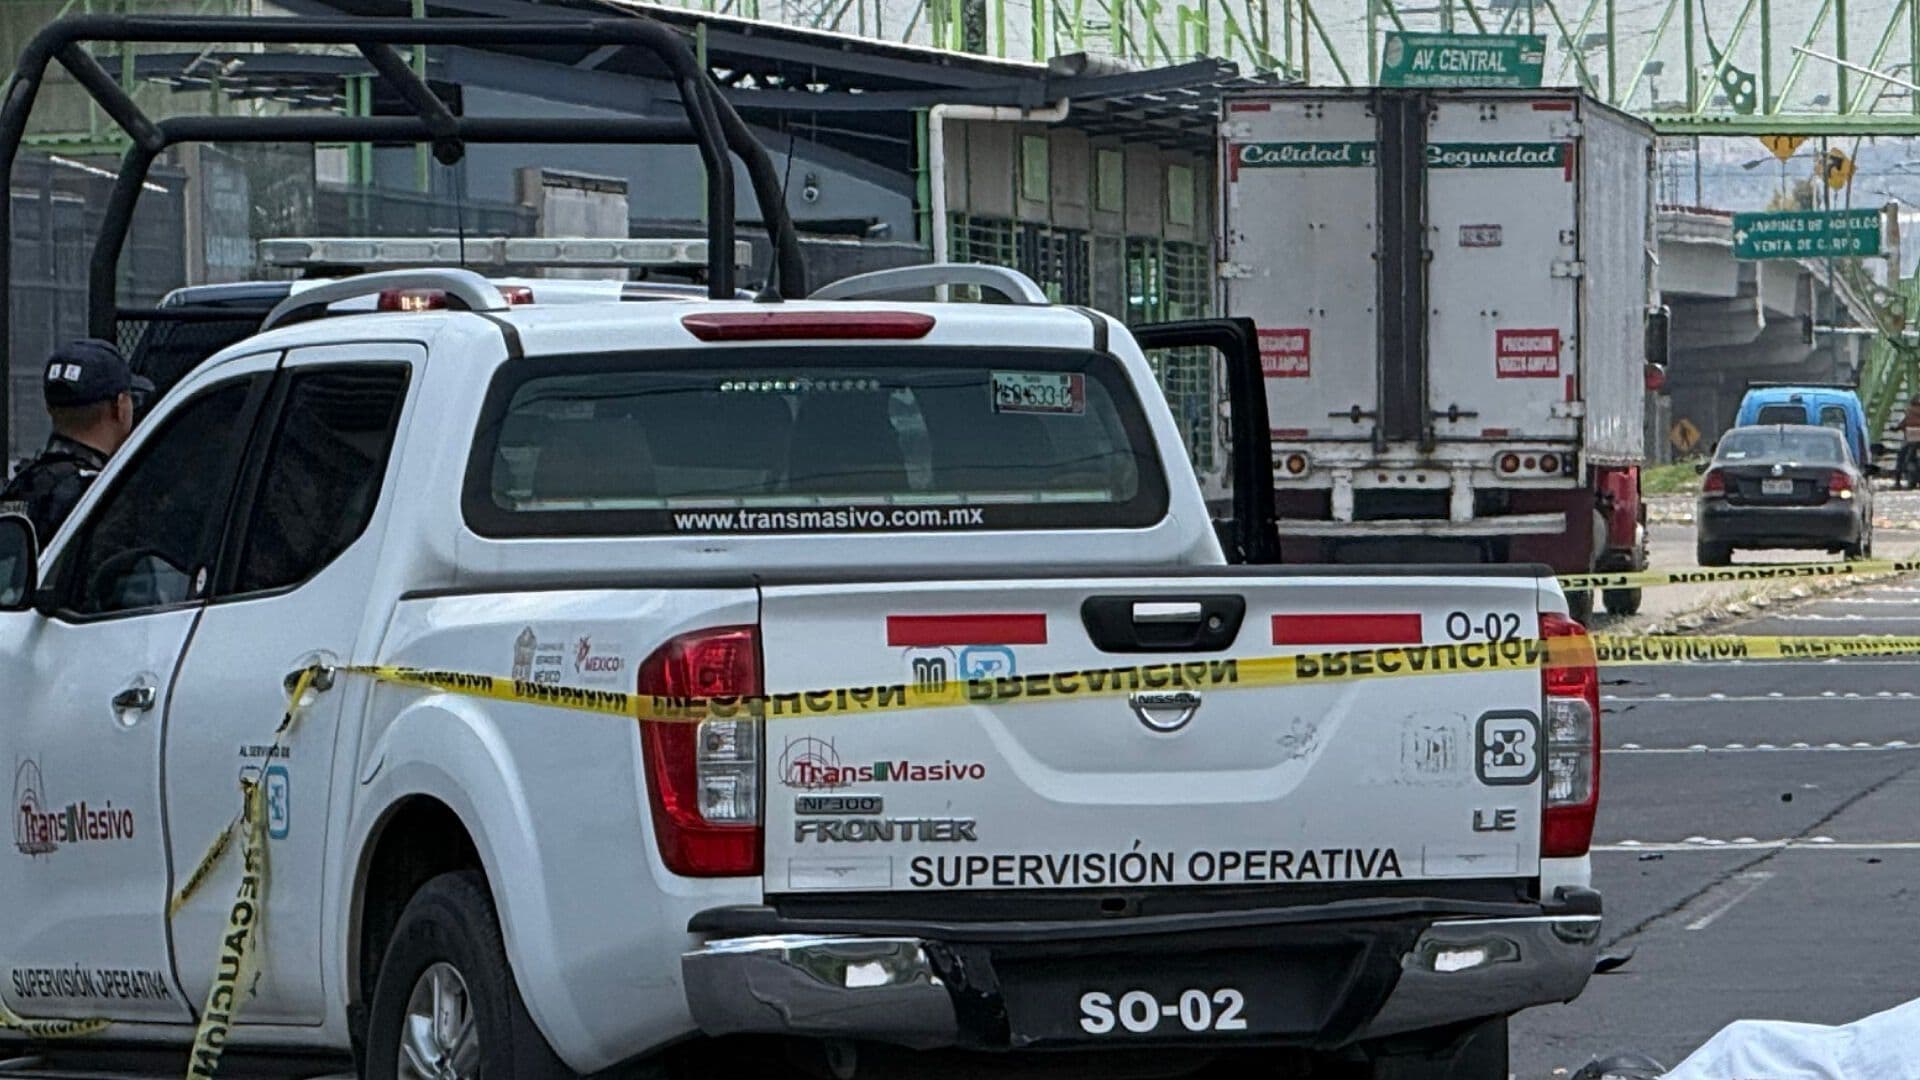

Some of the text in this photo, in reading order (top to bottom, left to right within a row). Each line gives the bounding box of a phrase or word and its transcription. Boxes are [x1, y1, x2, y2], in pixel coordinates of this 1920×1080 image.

[1411, 49, 1435, 71] AV.
[1439, 49, 1507, 72] CENTRAL
[1240, 145, 1556, 167] Calidad y Seguridad
[1753, 238, 1861, 252] VENTA DE CRPO
[674, 507, 984, 530] www.transmasivo.com.mx
[1446, 611, 1521, 641] O-02
[803, 798, 875, 811] NP300
[794, 817, 978, 843] FRONTIER
[1472, 808, 1517, 832] LE
[909, 839, 1404, 888] SUPERVISIÓN OPERATIVA
[12, 962, 172, 999] SUPERVISIÓN OPERATIVA
[1080, 988, 1247, 1034] SO-02
